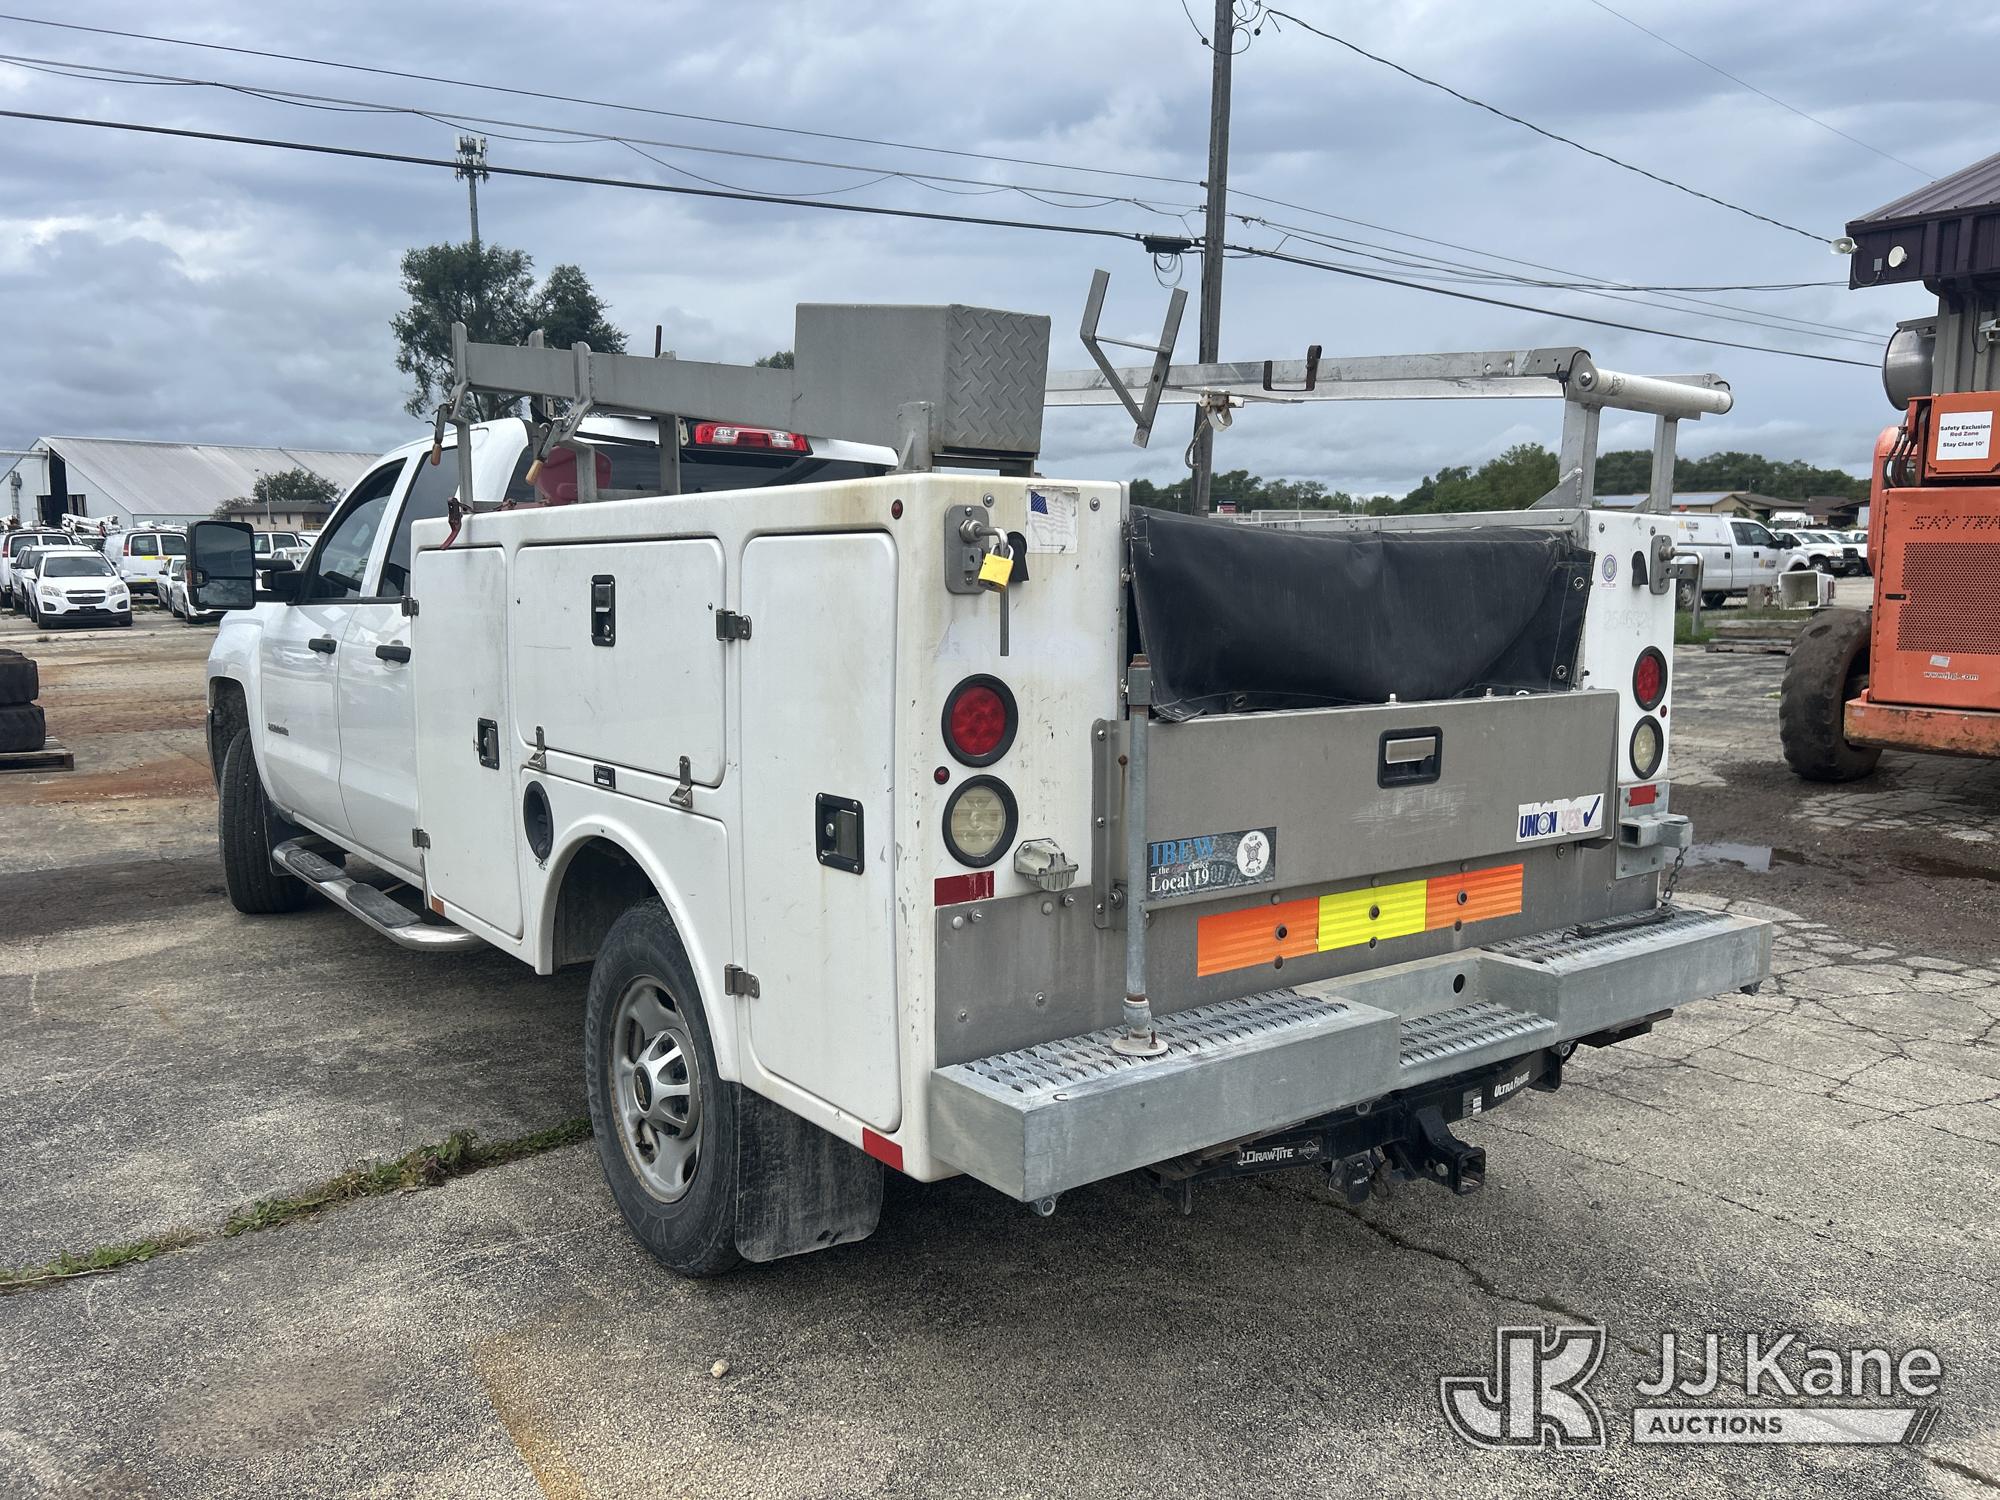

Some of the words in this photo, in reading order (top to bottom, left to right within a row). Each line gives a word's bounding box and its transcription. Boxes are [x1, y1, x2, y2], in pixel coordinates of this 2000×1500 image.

[1961, 423, 1990, 431] Exclusion
[1520, 811, 1558, 838] UNION
[1151, 836, 1217, 867] IBEW
[1151, 871, 1190, 892] Local
[1195, 868, 1209, 886] 19
[1159, 866, 1170, 875] the
[1494, 1081, 1513, 1097] ULTRA
